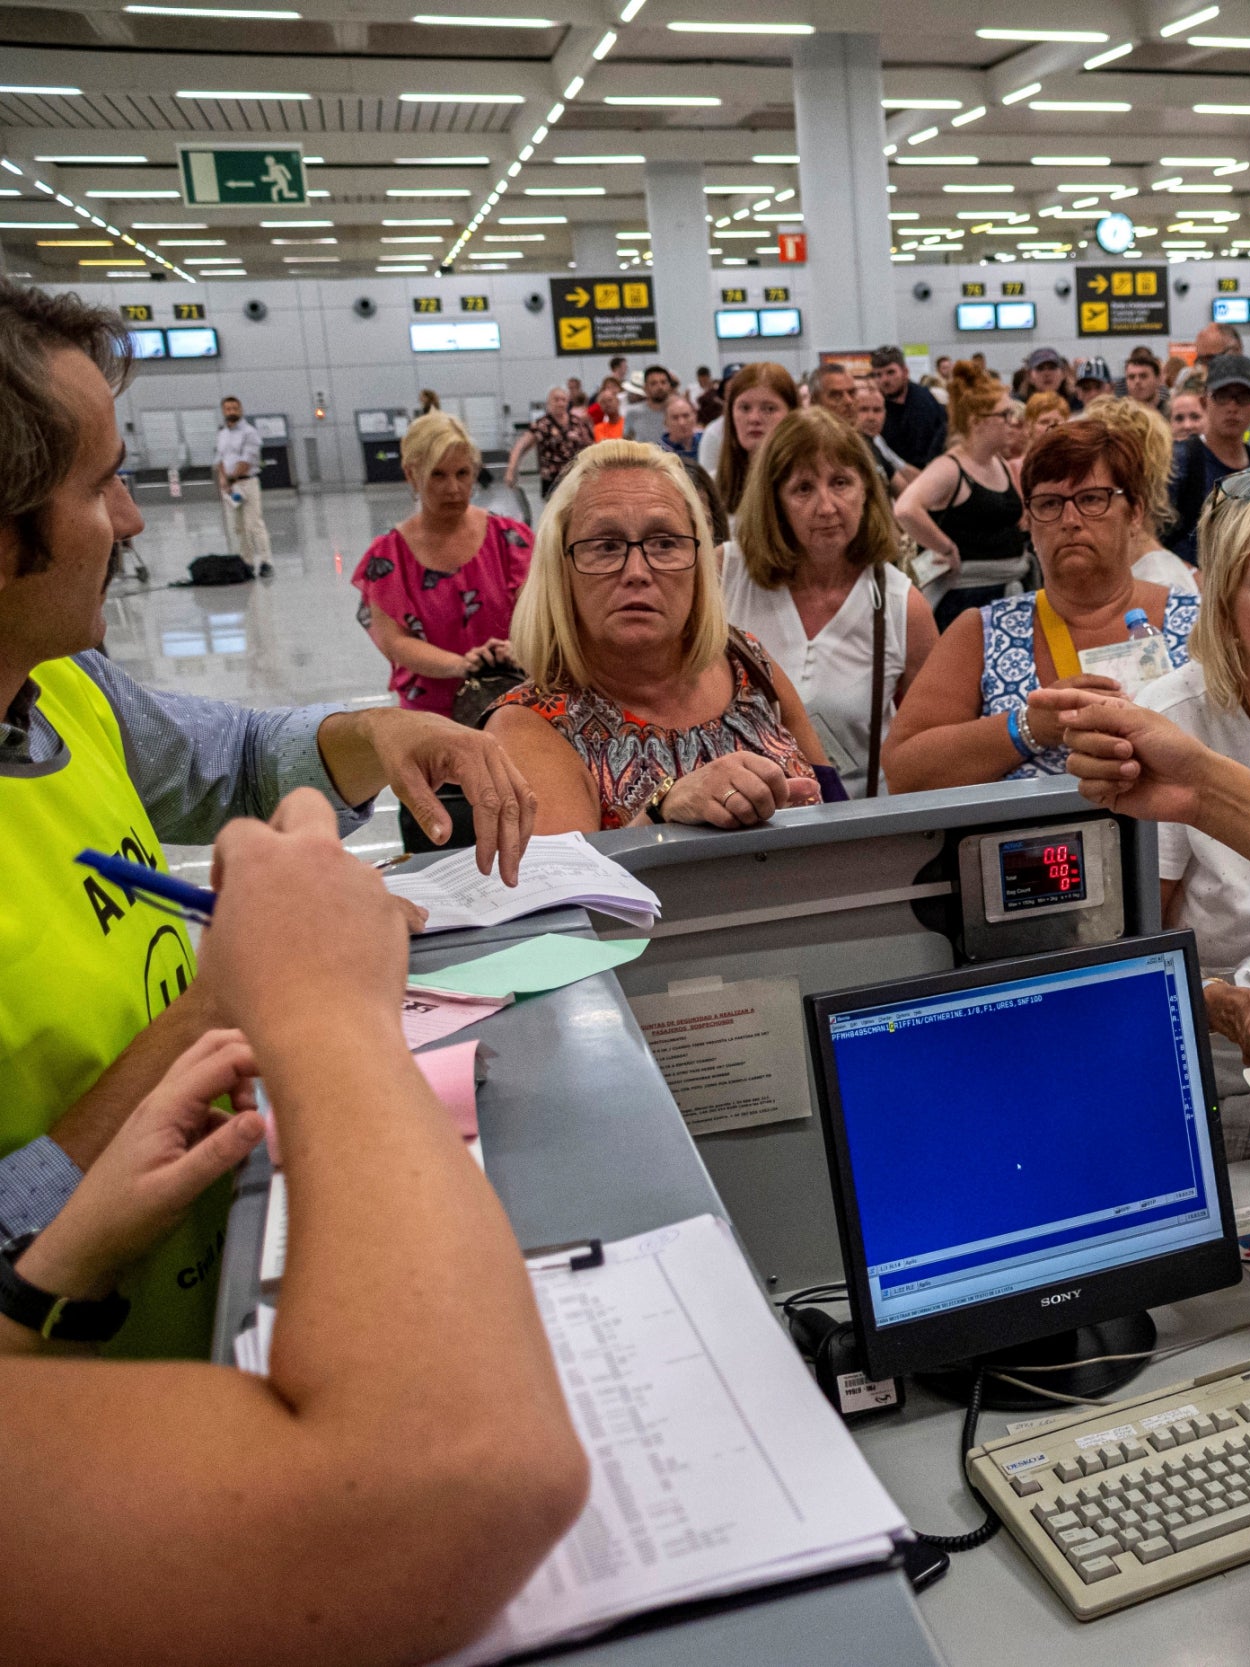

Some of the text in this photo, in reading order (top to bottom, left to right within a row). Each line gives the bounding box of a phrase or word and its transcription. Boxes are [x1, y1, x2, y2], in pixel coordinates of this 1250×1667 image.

[126, 305, 148, 321] 70
[179, 304, 199, 320] 71
[1041, 1290, 1082, 1307] SONY
